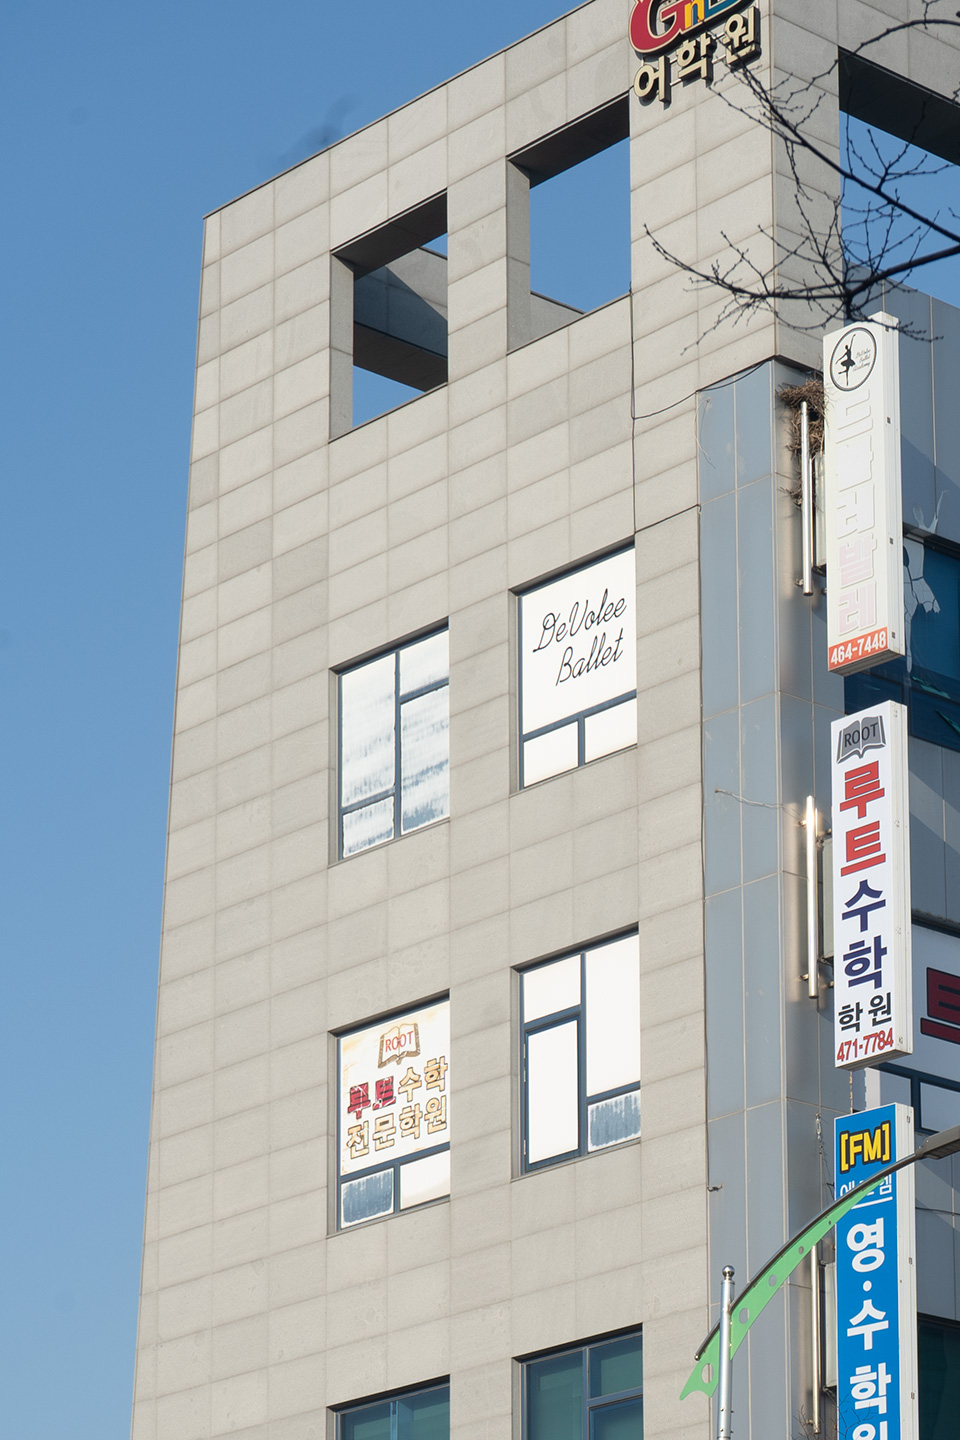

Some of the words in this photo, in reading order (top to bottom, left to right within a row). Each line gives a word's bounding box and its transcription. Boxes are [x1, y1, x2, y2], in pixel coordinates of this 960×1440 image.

[633, 6, 759, 103] 어학원
[533, 588, 627, 653] DeVolee
[556, 628, 623, 686] Ballet
[830, 630, 886, 665] 464-7448
[844, 722, 878, 749] ROOT
[838, 991, 892, 1033] 학원
[385, 1031, 413, 1053] ROOT
[836, 1027, 894, 1062] 471-7784
[347, 1095, 448, 1160] 전문학원
[841, 1121, 890, 1173] [FM]
